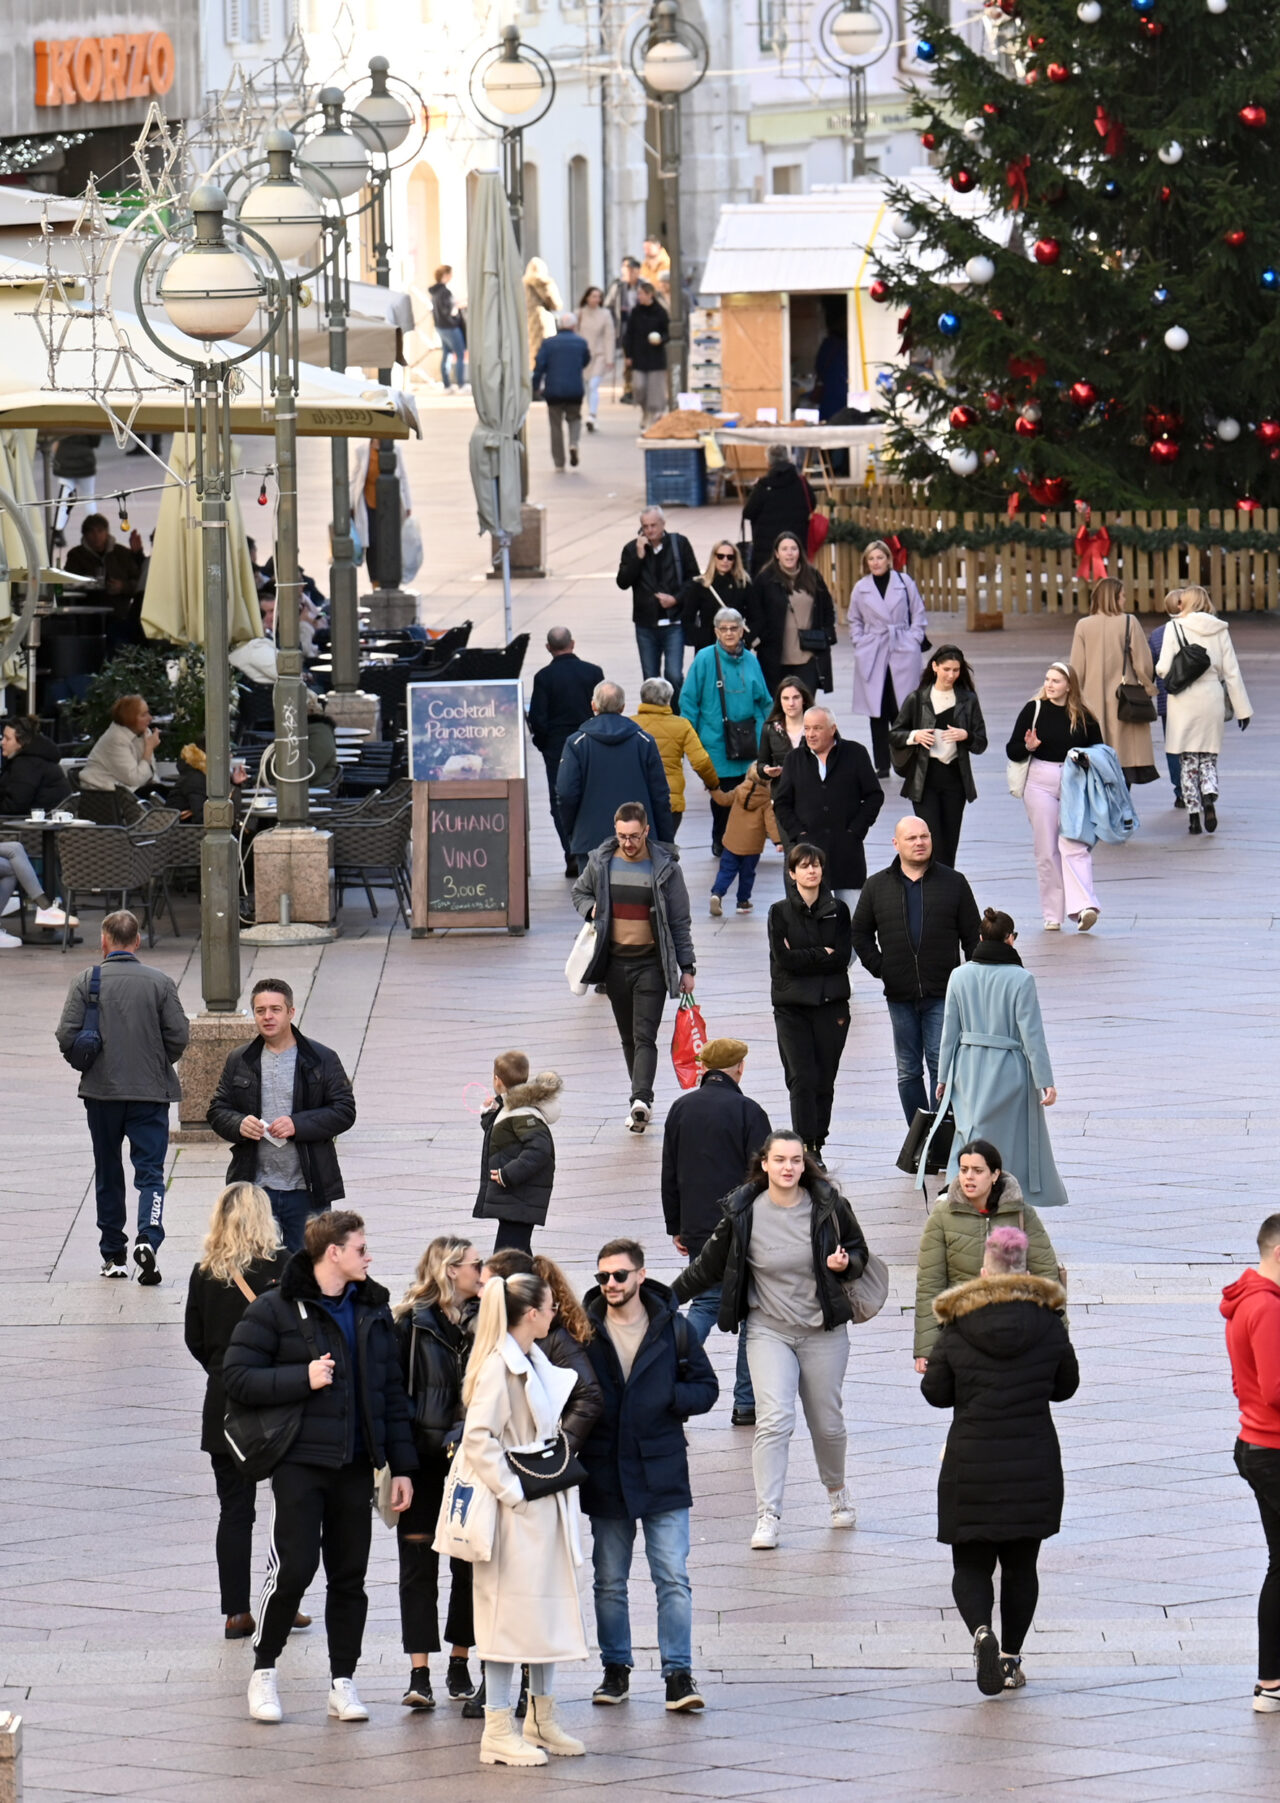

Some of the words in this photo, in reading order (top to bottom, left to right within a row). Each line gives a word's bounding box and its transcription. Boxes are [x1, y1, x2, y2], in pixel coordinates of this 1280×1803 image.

[35, 31, 175, 106] KORZO
[428, 700, 496, 719] Cocktail
[425, 720, 506, 740] Panettone
[431, 810, 505, 833] KUHANO
[442, 846, 488, 869] VINO
